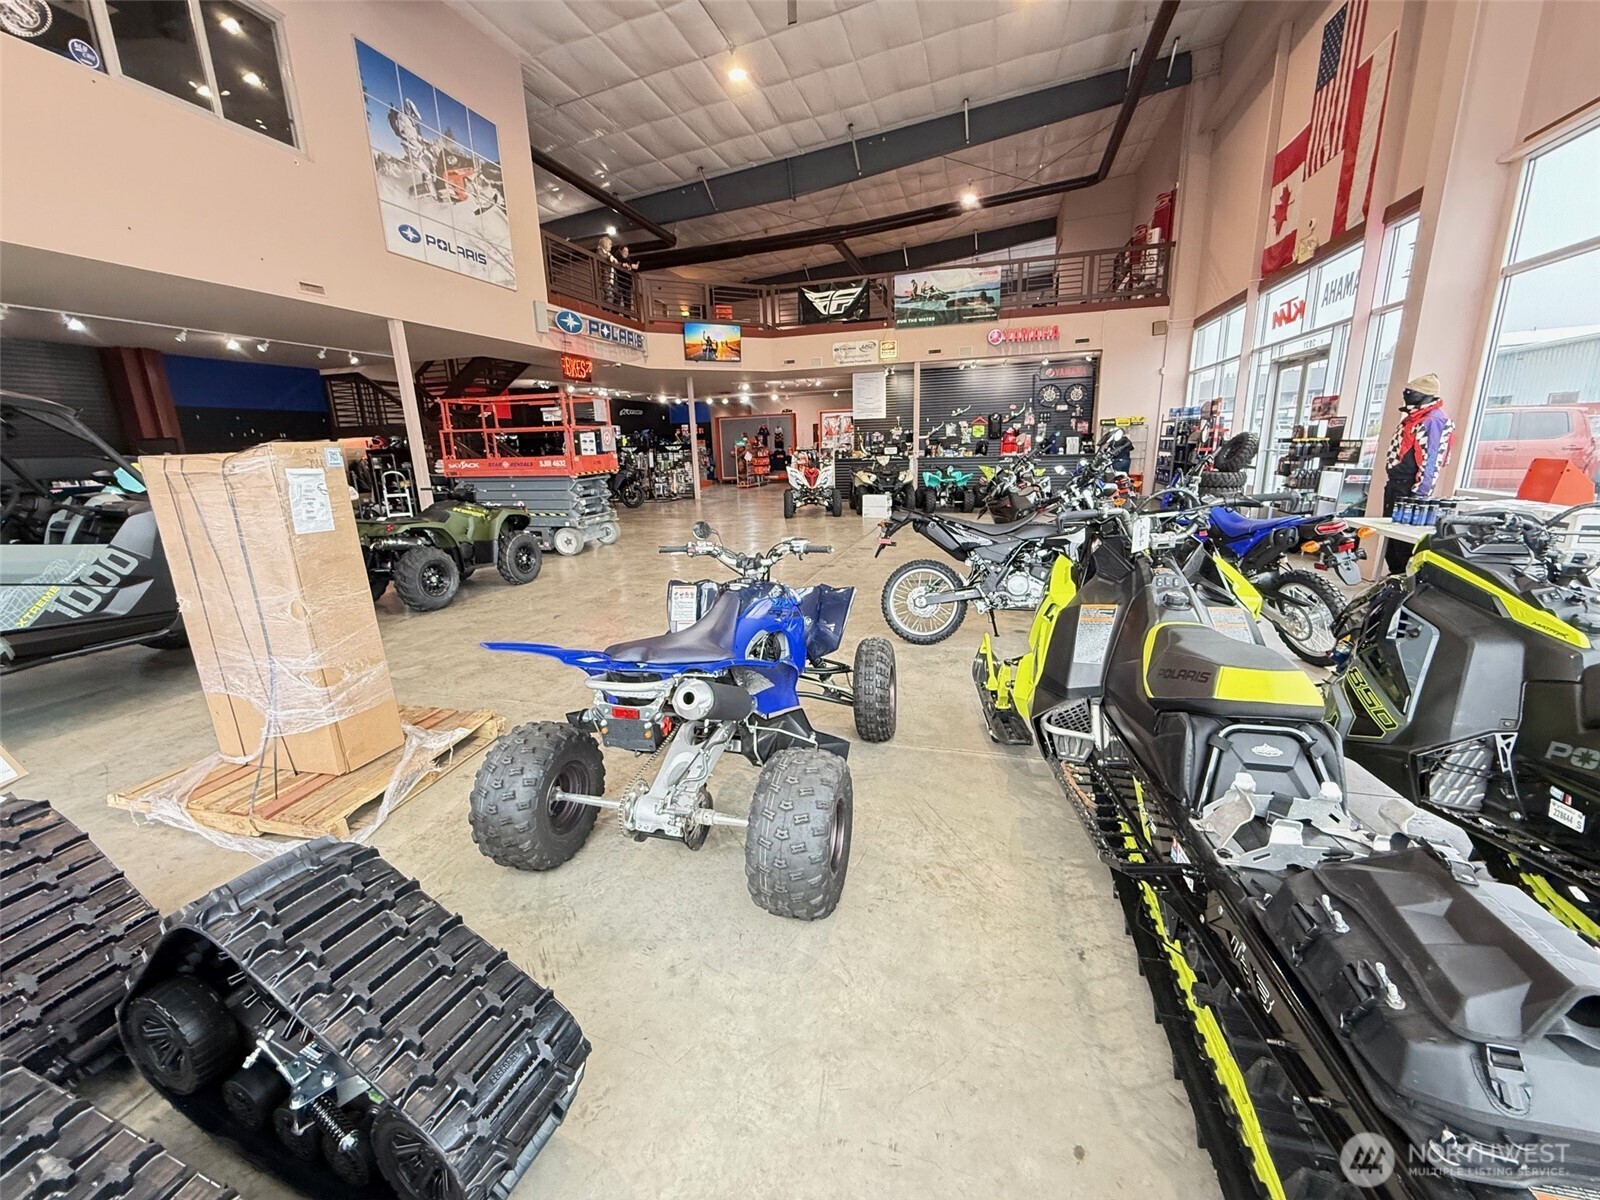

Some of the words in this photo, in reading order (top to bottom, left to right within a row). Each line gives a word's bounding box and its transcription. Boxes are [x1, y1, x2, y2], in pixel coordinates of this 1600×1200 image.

[425, 233, 487, 265] POLARIS
[587, 319, 644, 349] POLARIS
[1004, 325, 1059, 343] YAMAHA
[564, 357, 587, 378] BIKES
[1055, 366, 1087, 376] YAMAHA
[448, 461, 480, 469] SKYJACK
[46, 547, 139, 618] 1000
[16, 585, 59, 628] XTREME
[1157, 668, 1211, 683] POLARIS
[1346, 666, 1399, 731] 850
[1545, 741, 1600, 770] PO
